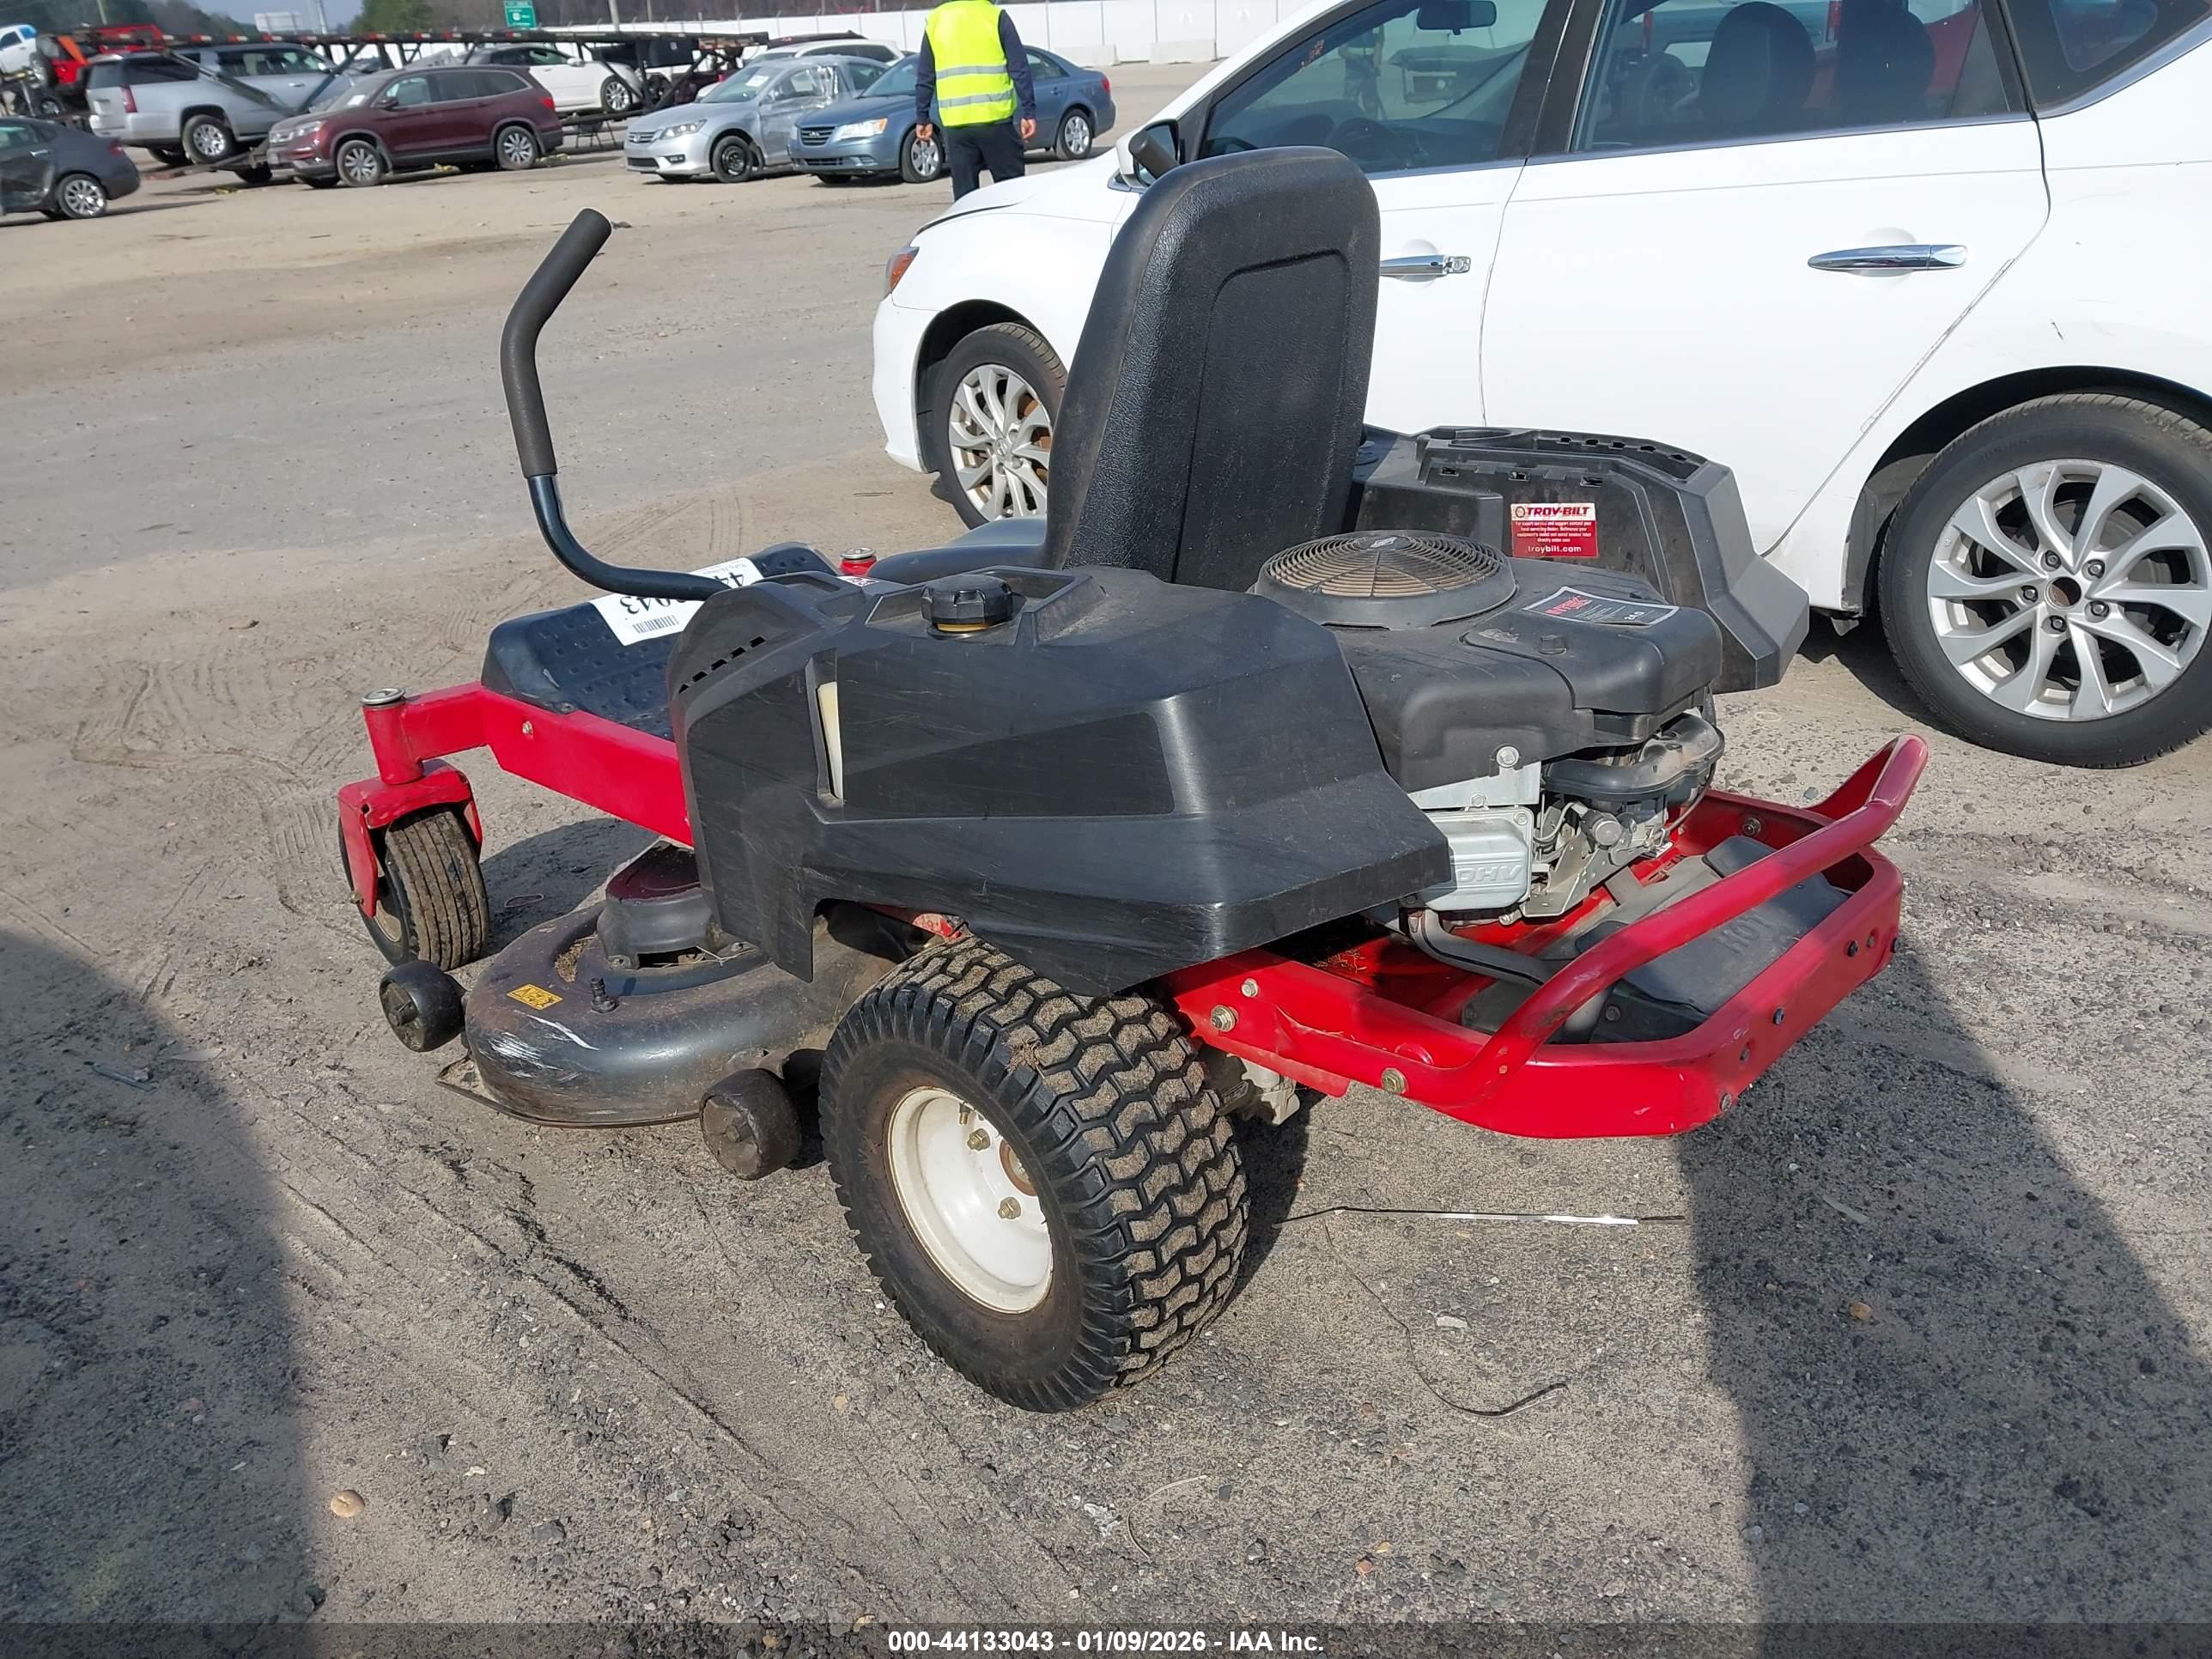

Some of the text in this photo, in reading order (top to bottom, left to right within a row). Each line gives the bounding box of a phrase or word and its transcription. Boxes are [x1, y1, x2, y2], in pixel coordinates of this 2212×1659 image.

[1527, 507, 1589, 516] TROY-BILT
[1528, 544, 1582, 554] troybilt.com
[1456, 864, 1522, 883] OHV
